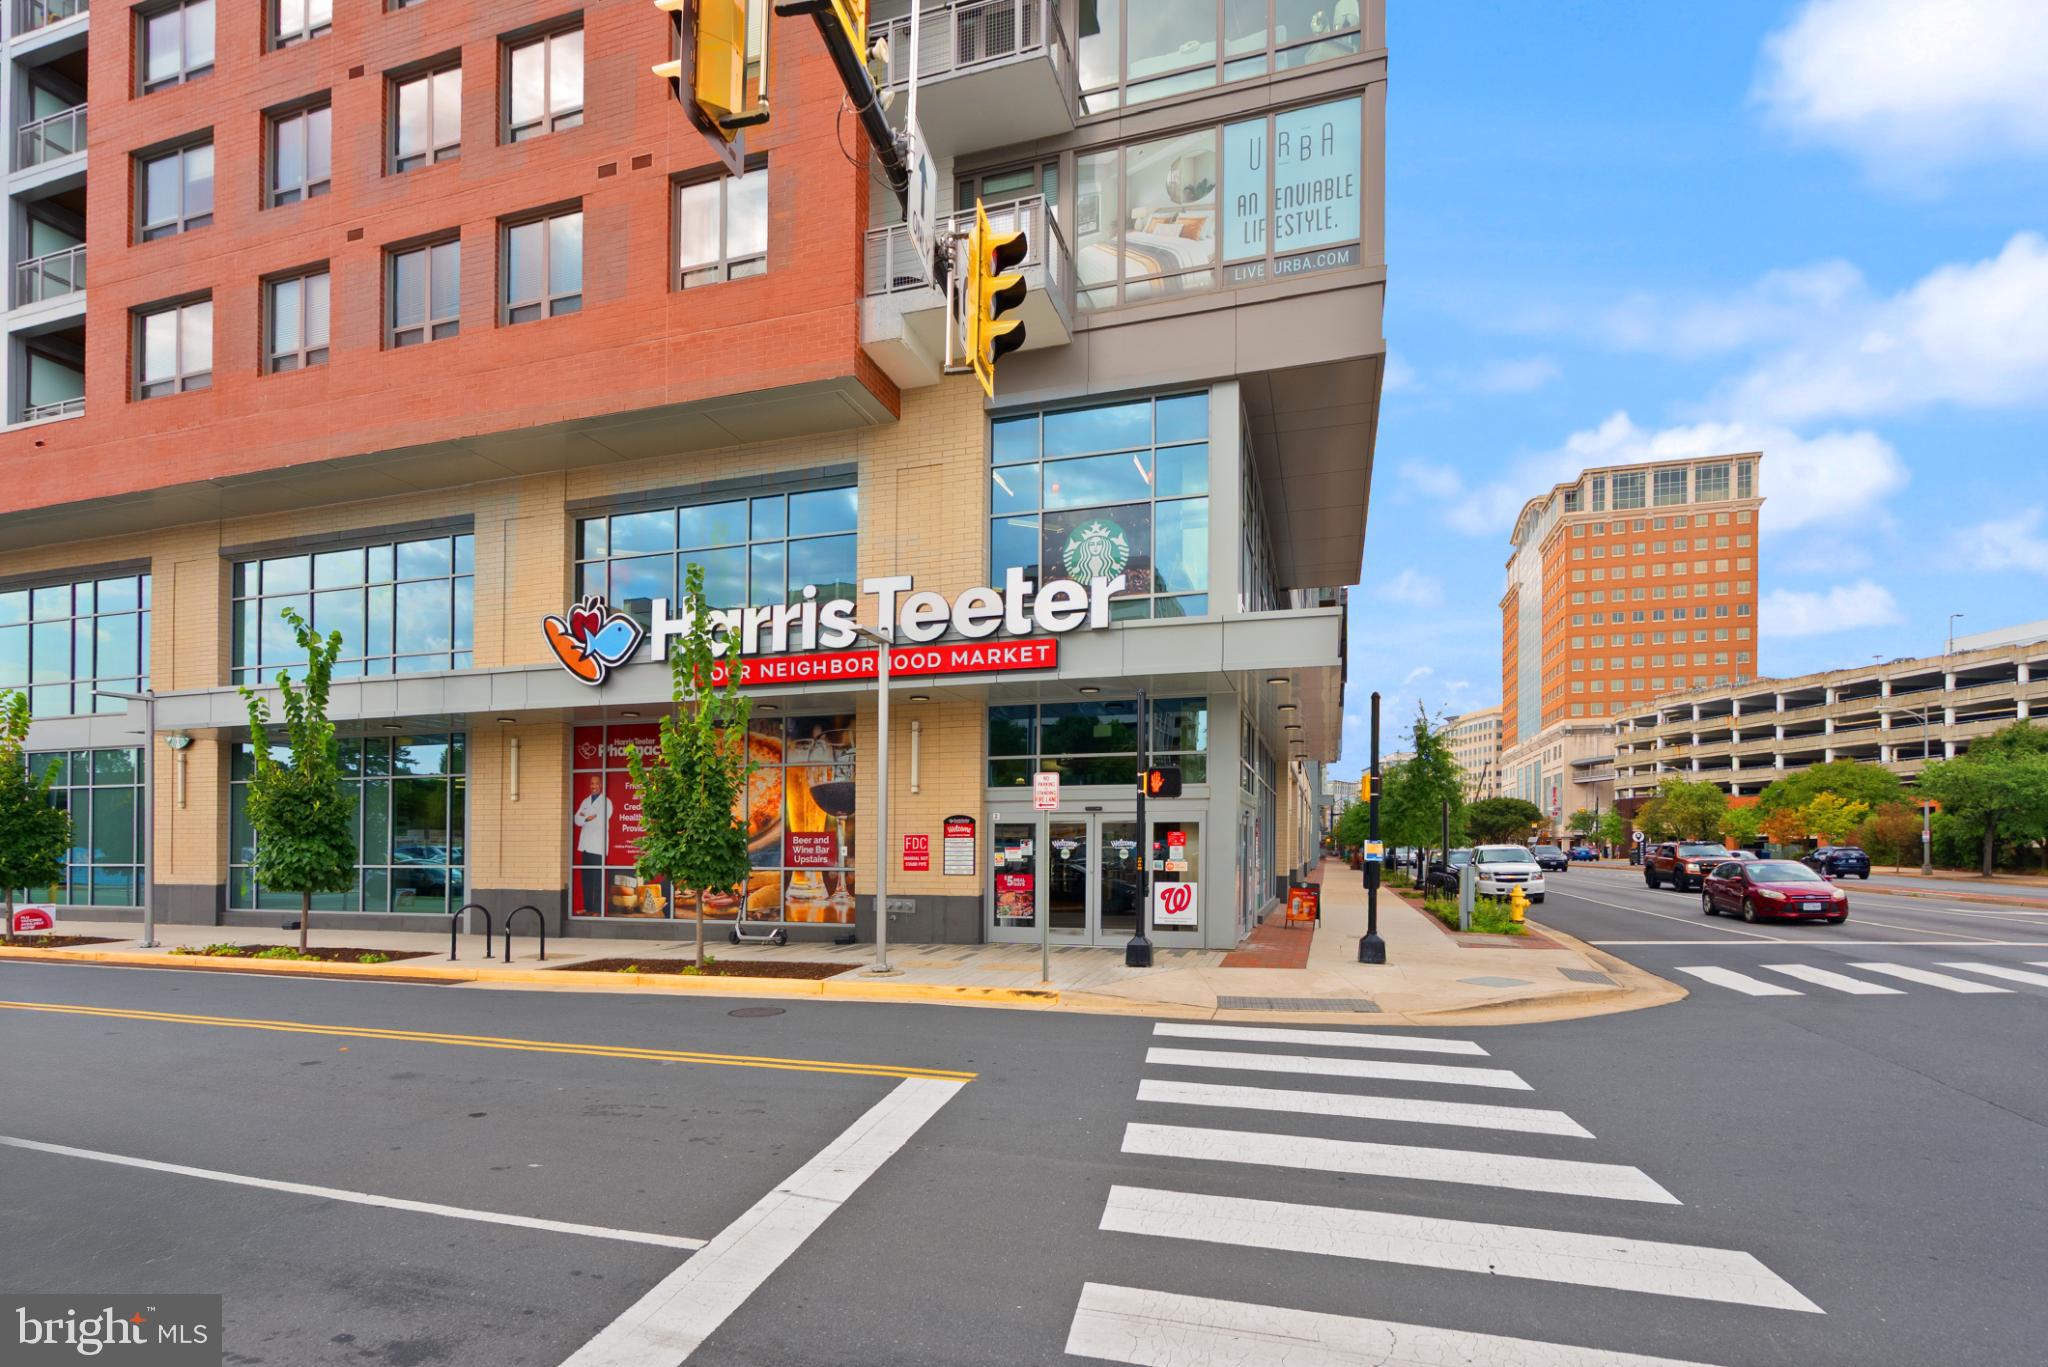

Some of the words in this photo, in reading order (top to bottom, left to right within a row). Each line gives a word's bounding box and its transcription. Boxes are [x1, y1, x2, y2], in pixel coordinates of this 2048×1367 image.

[1250, 122, 1333, 170] URBA
[1238, 192, 1258, 217] AN
[1275, 174, 1353, 210] ENVIABLE
[1244, 206, 1338, 244] LIFESTYLE.
[650, 584, 858, 661] Harris
[863, 566, 1126, 645] Teeter
[951, 645, 1050, 667] MARKET
[792, 836, 812, 845] Beer
[813, 836, 830, 845] and
[792, 846, 814, 854] Wine
[815, 846, 830, 854] Bar
[905, 837, 927, 850] FDC
[793, 855, 828, 865] Upstairs
